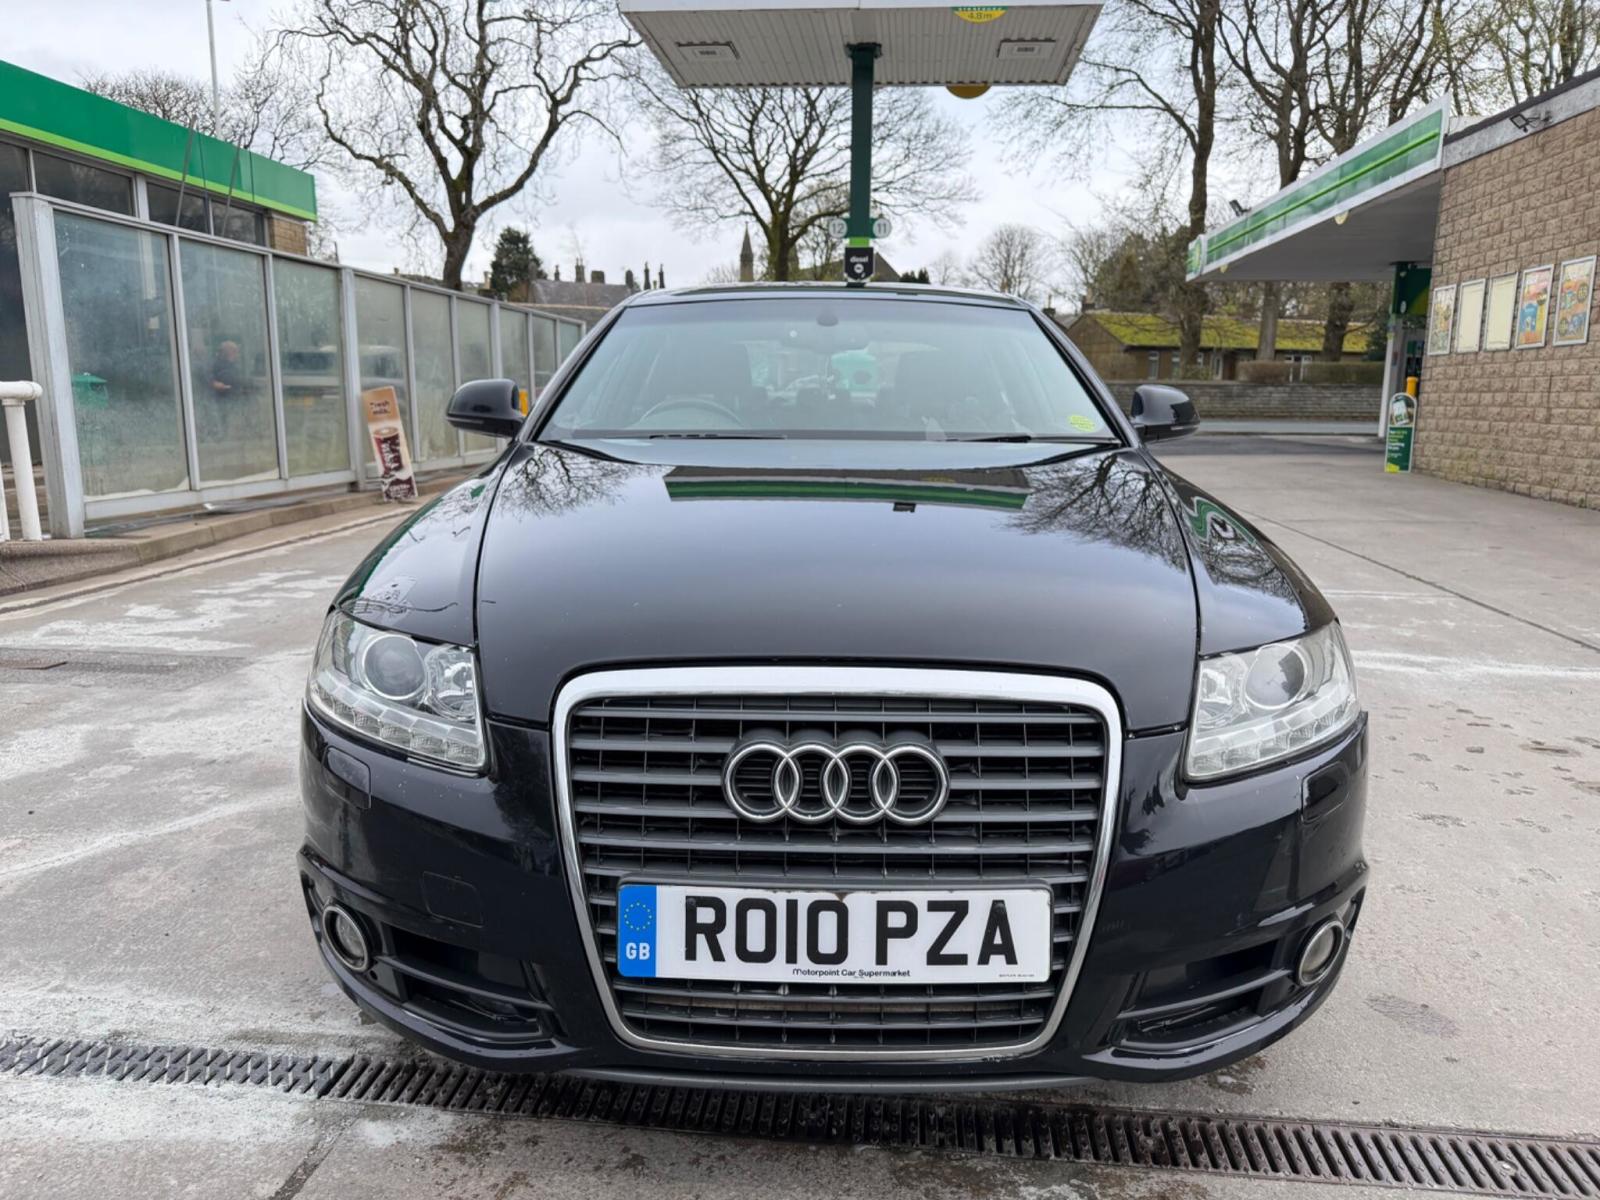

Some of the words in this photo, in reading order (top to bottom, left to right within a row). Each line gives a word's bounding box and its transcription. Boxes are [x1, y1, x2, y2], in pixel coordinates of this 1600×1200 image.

[831, 223, 844, 234] 12
[877, 223, 887, 234] 11
[684, 895, 849, 965] RO10
[875, 898, 1018, 967] PZA
[625, 942, 650, 960] GB
[792, 968, 840, 978] Motorpoint
[841, 968, 856, 977] Car
[858, 969, 911, 978] Supermarket
